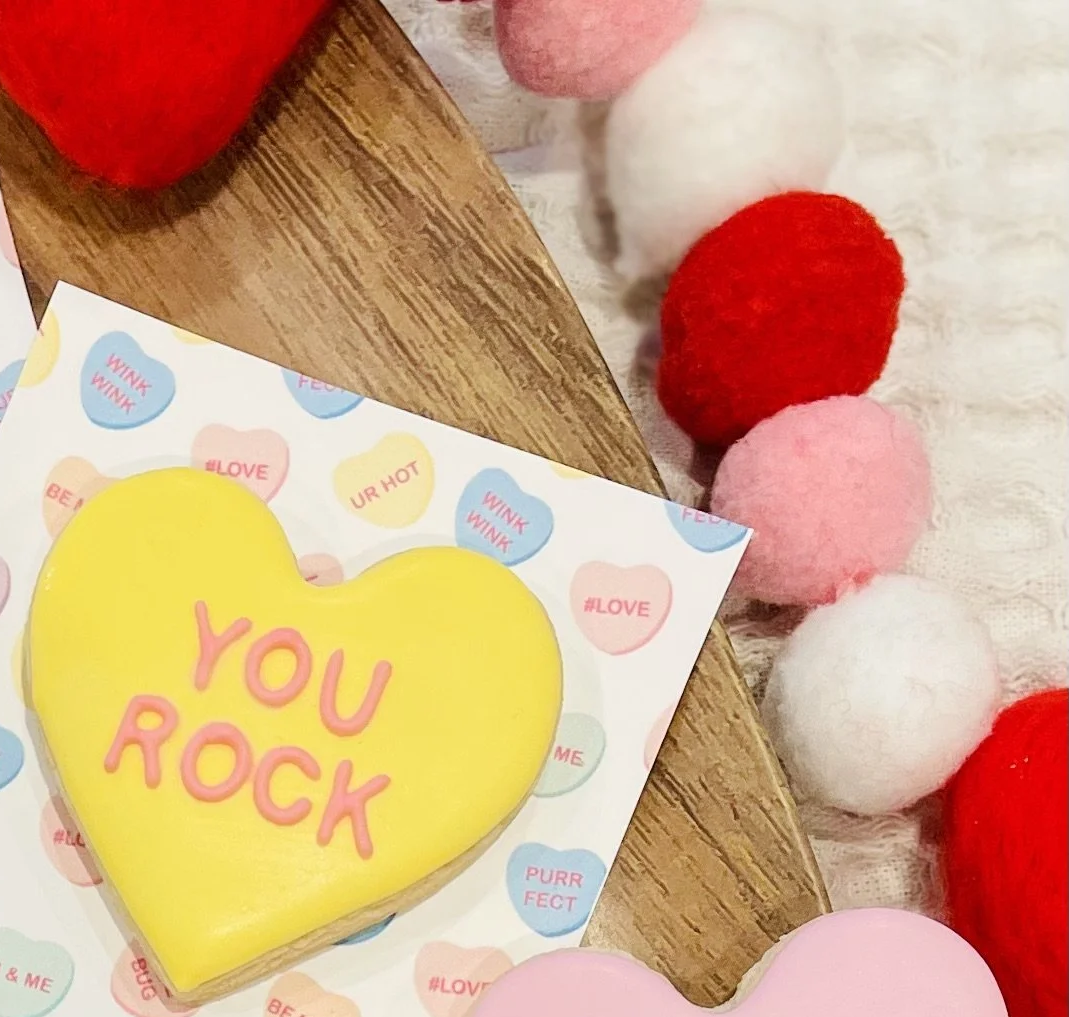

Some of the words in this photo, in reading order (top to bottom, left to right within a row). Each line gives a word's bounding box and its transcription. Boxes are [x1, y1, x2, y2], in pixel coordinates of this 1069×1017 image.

[105, 353, 153, 397] WINK
[90, 372, 136, 414] WINK
[205, 459, 269, 480] #LOVE
[349, 486, 380, 510] UR
[381, 461, 422, 490] HOT
[46, 483, 73, 507] BE
[483, 491, 531, 534] WINK
[466, 510, 513, 553] WINK
[583, 596, 651, 618] #LOVE
[193, 599, 393, 738] YOU
[554, 745, 584, 768] ME
[103, 693, 392, 861] ROCK
[525, 866, 584, 888] PURR
[523, 890, 577, 912] FECT
[5, 966, 20, 983] &
[19, 969, 54, 993] ME
